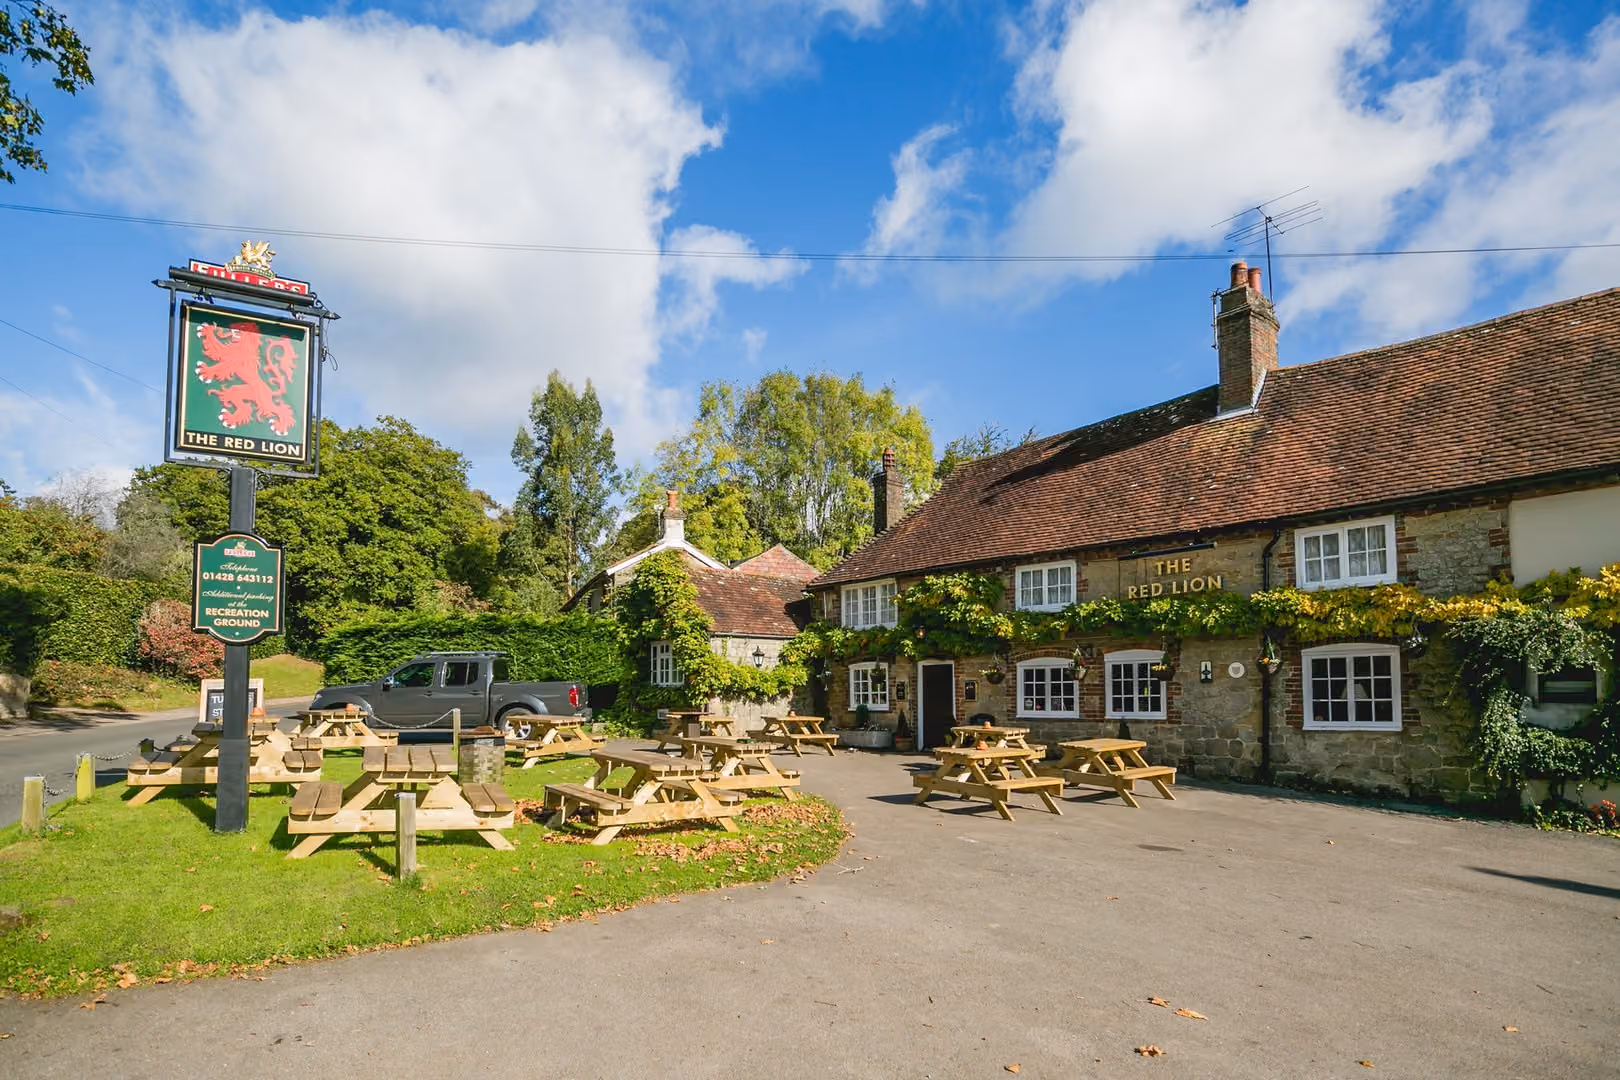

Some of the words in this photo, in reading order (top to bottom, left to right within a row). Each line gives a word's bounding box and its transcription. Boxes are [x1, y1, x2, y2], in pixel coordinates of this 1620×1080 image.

[186, 432, 218, 446] THE
[224, 436, 255, 450] RED
[261, 441, 300, 456] LION
[220, 562, 258, 573] Telephone
[1154, 558, 1191, 575] THE
[203, 572, 234, 582] 01428
[237, 573, 273, 584] 643112
[1128, 583, 1163, 599] RED
[1172, 575, 1222, 595] LION
[202, 588, 246, 599] Additional
[244, 592, 274, 602] parking
[205, 607, 269, 618] RECREATION
[213, 618, 260, 628] GROUND
